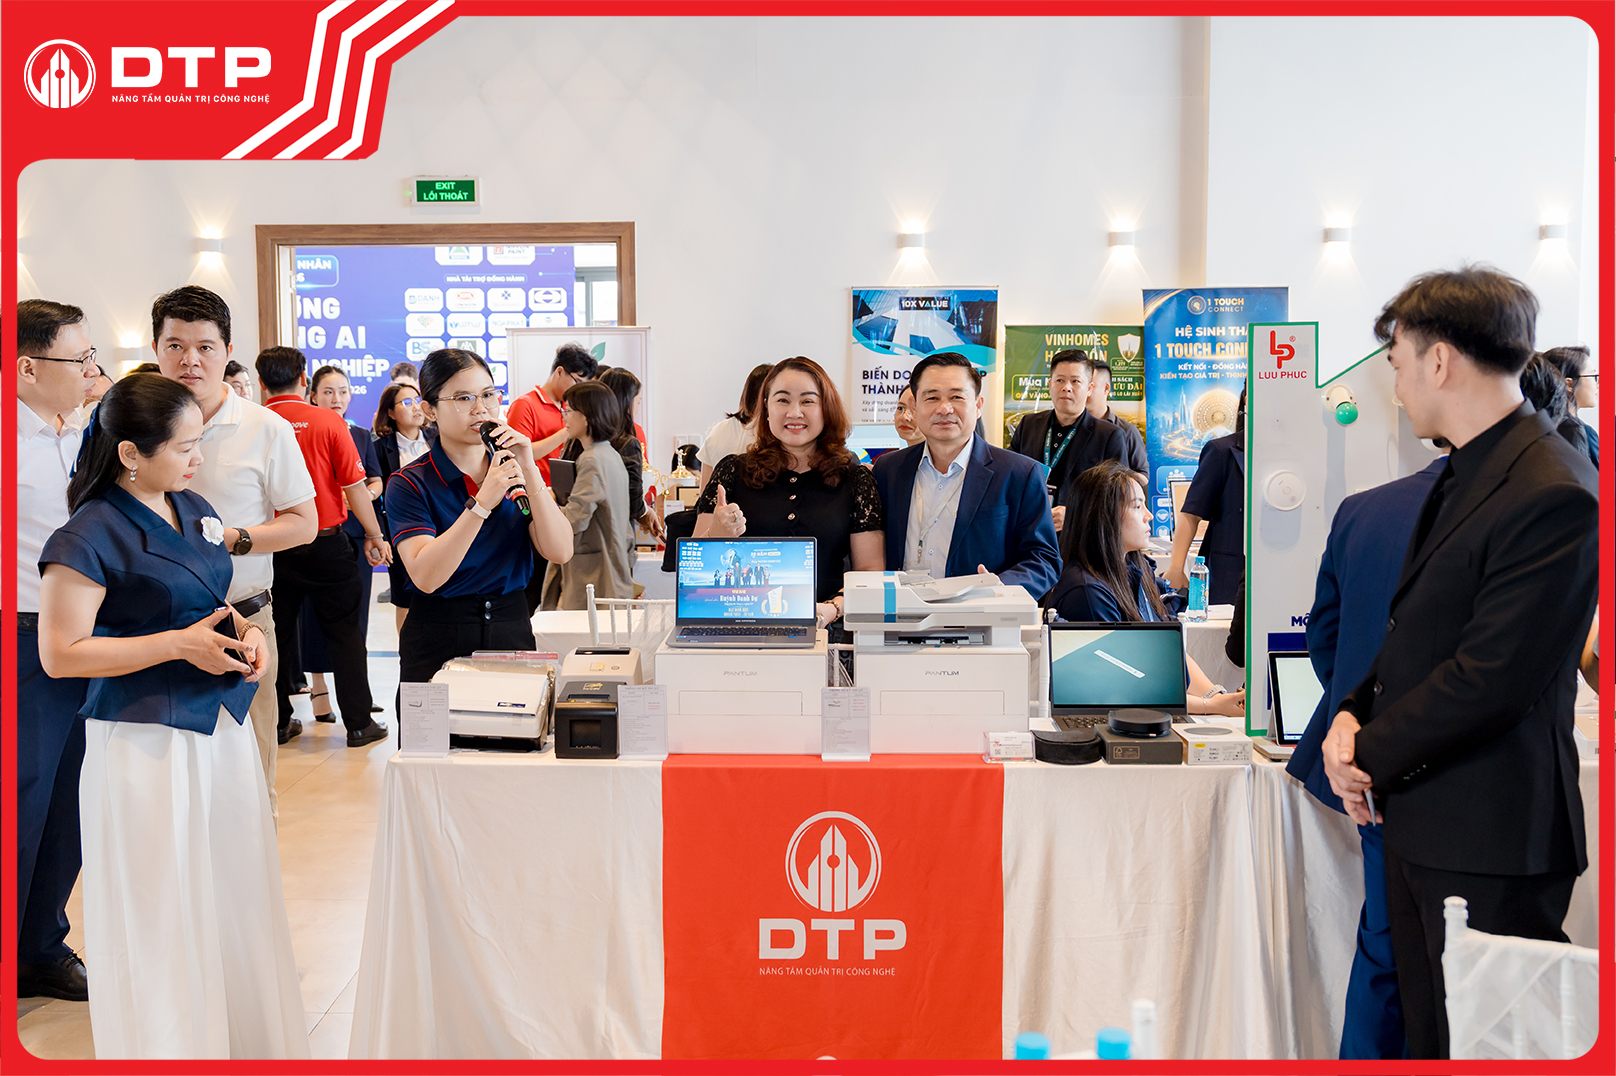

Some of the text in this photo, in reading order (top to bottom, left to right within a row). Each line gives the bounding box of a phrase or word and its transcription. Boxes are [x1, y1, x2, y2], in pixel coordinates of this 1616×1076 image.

[435, 182, 456, 190] EXIT
[439, 190, 469, 200] THOÁT
[297, 258, 332, 270] NHÂN
[901, 300, 948, 308] 10X VALUE
[1207, 298, 1244, 306] 1 TOUCH
[335, 326, 366, 349] AI
[1175, 325, 1193, 339] HỆ
[1195, 326, 1226, 337] SINH
[1045, 333, 1109, 346] VINHOMES
[1155, 343, 1161, 358] 1
[1166, 342, 1211, 358] TOUCH
[1178, 362, 1192, 371] KẾT
[1193, 362, 1206, 370] NỐI
[862, 365, 889, 380] BIẾN
[1160, 371, 1177, 379] KIẾN
[1178, 372, 1193, 380] TẠO
[1194, 371, 1207, 379] GIÁ
[759, 918, 907, 960] DTP
[759, 966, 783, 976] NÂNG
[831, 967, 844, 977] TRỊ
[846, 966, 870, 976] CÔNG
